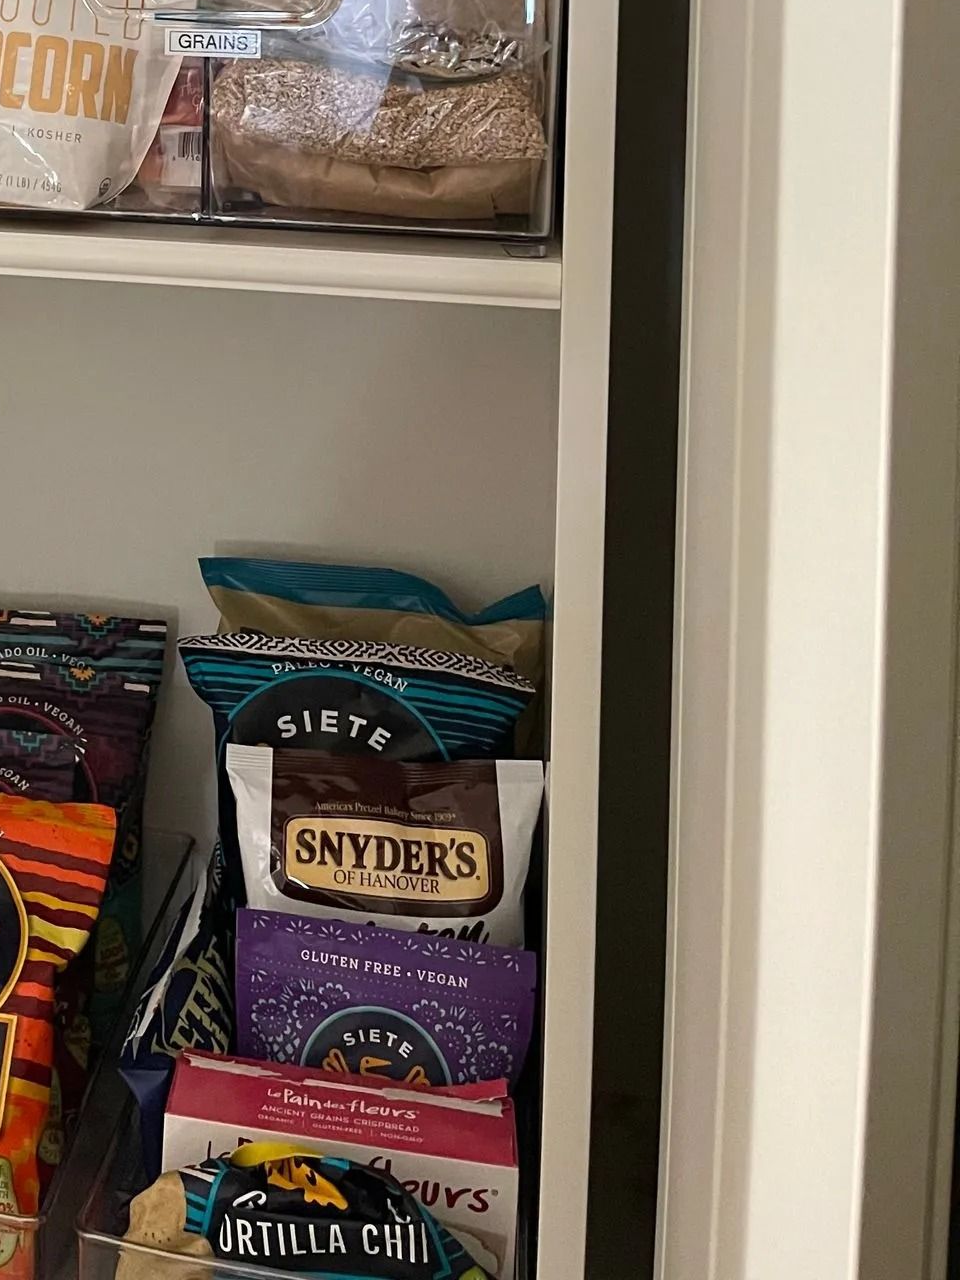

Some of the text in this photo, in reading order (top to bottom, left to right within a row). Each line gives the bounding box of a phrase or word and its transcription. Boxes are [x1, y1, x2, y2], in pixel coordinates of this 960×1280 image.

[179, 33, 248, 51] GRAINS
[27, 128, 83, 144] KOSHER
[26, 647, 48, 658] OIL
[352, 664, 408, 693] VEGAN
[8, 696, 31, 706] OIL
[43, 701, 84, 735] VEGAN
[277, 709, 391, 751] SIETE
[355, 802, 382, 813] Pretzel
[384, 806, 409, 819] Bakery
[295, 828, 480, 881] SNYDER'S
[333, 870, 440, 894] OF HANOVER
[301, 949, 469, 988] GLUTEN FREE VEGAN
[343, 1028, 414, 1058] SIETE
[267, 1088, 417, 1119] Le Pain des fleurs
[261, 1105, 420, 1133] ANCIENT GRAINS CRISPBREAD
